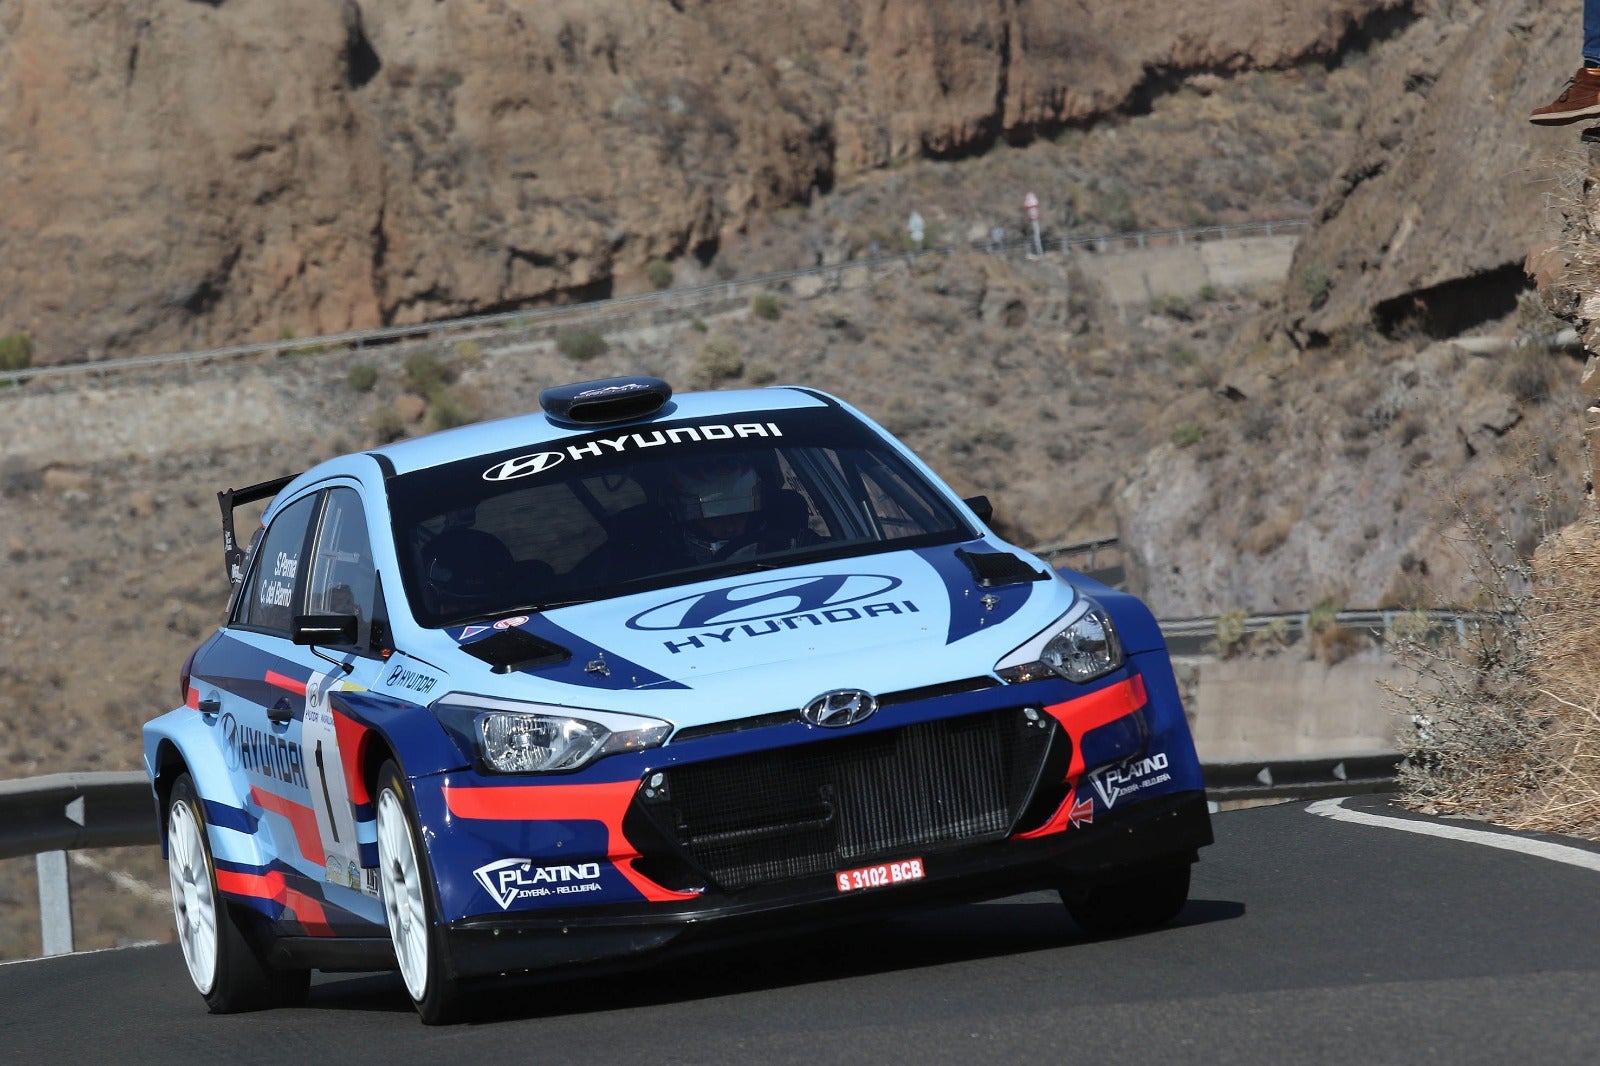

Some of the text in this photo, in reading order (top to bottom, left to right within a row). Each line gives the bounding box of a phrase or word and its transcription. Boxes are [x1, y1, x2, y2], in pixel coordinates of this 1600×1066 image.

[565, 422, 783, 460] HYUNDAI
[663, 600, 920, 655] HYUNDAI
[397, 669, 438, 694] HYUNDAI
[240, 724, 309, 789] HYUNDAI
[1105, 752, 1169, 794] PLATINO
[315, 739, 340, 843] 1
[498, 862, 600, 894] PLATINO
[517, 887, 551, 899] JOYERÍA
[557, 882, 602, 895] RELOJERÍA
[839, 860, 922, 891] S 3102 BCB
